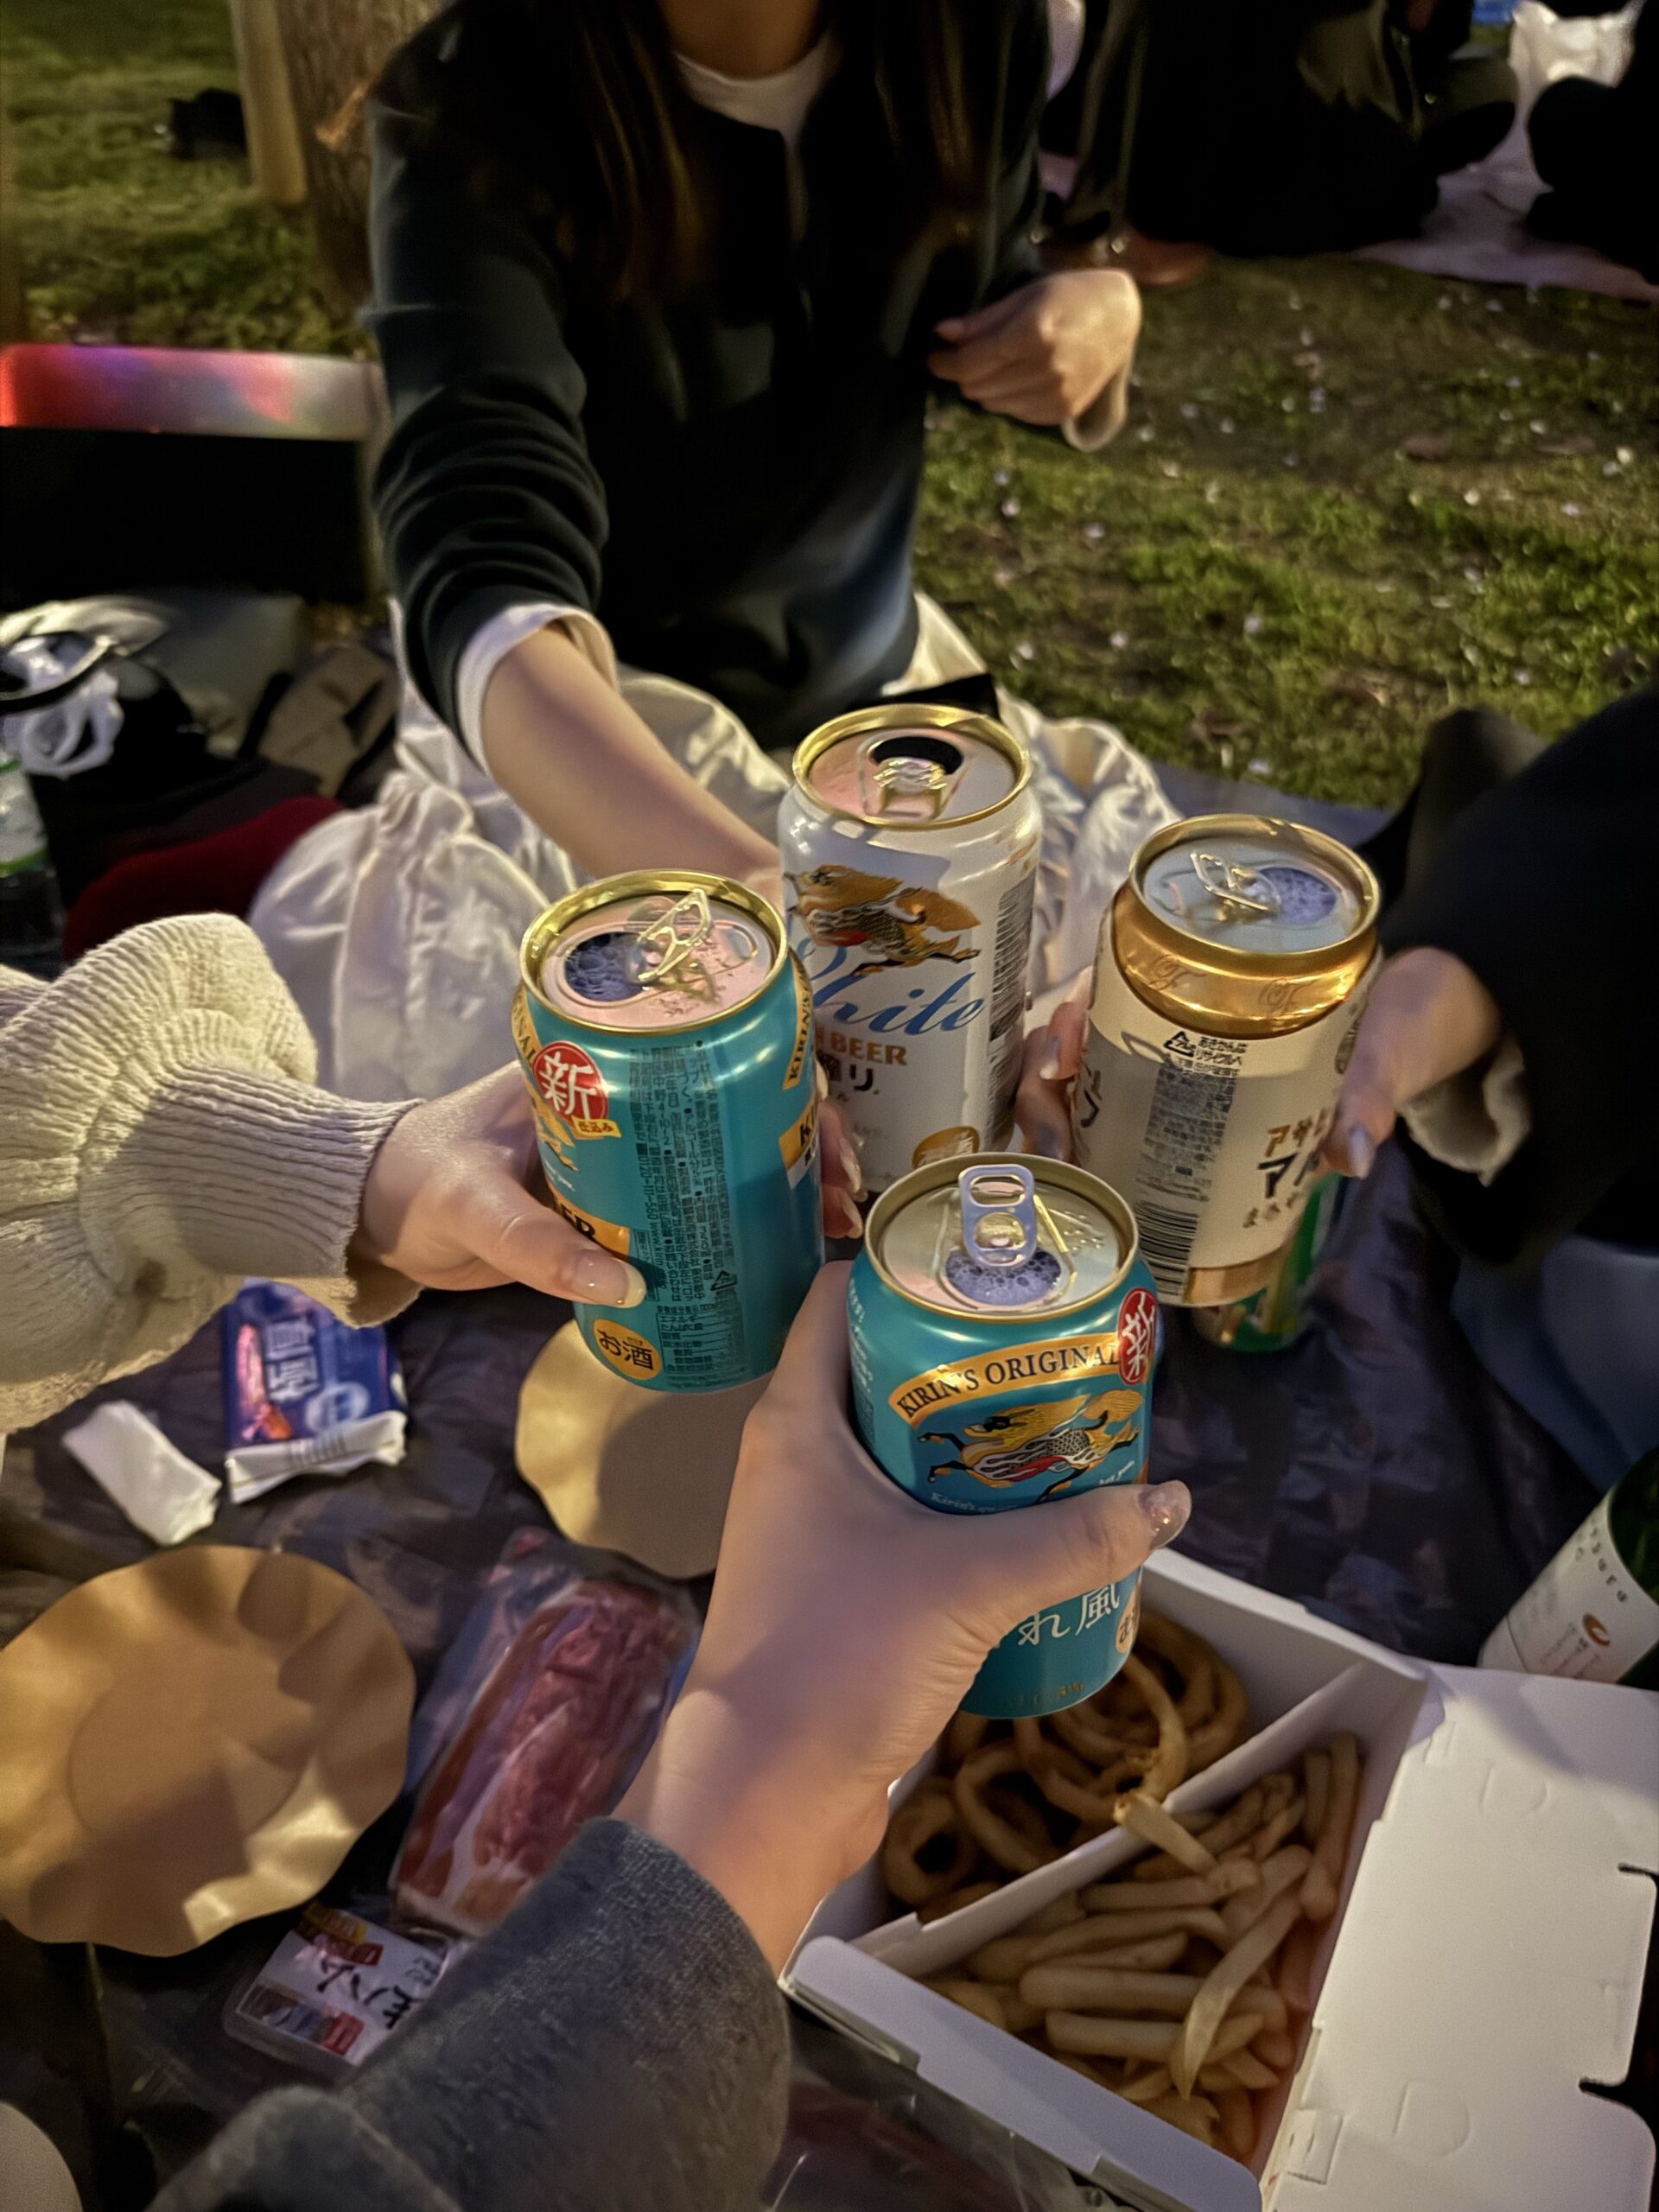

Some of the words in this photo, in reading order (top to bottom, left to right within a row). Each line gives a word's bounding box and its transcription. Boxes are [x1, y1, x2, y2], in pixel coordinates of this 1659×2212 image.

[830, 1031, 907, 1066] BEER
[539, 1052, 598, 1121] 新
[597, 1328, 654, 1370] お酒
[1122, 1291, 1155, 1382] 新
[897, 1368, 980, 1417] KIRIN'S
[984, 1344, 1119, 1385] ORIGINAL
[1018, 1583, 1120, 1646] れ風
